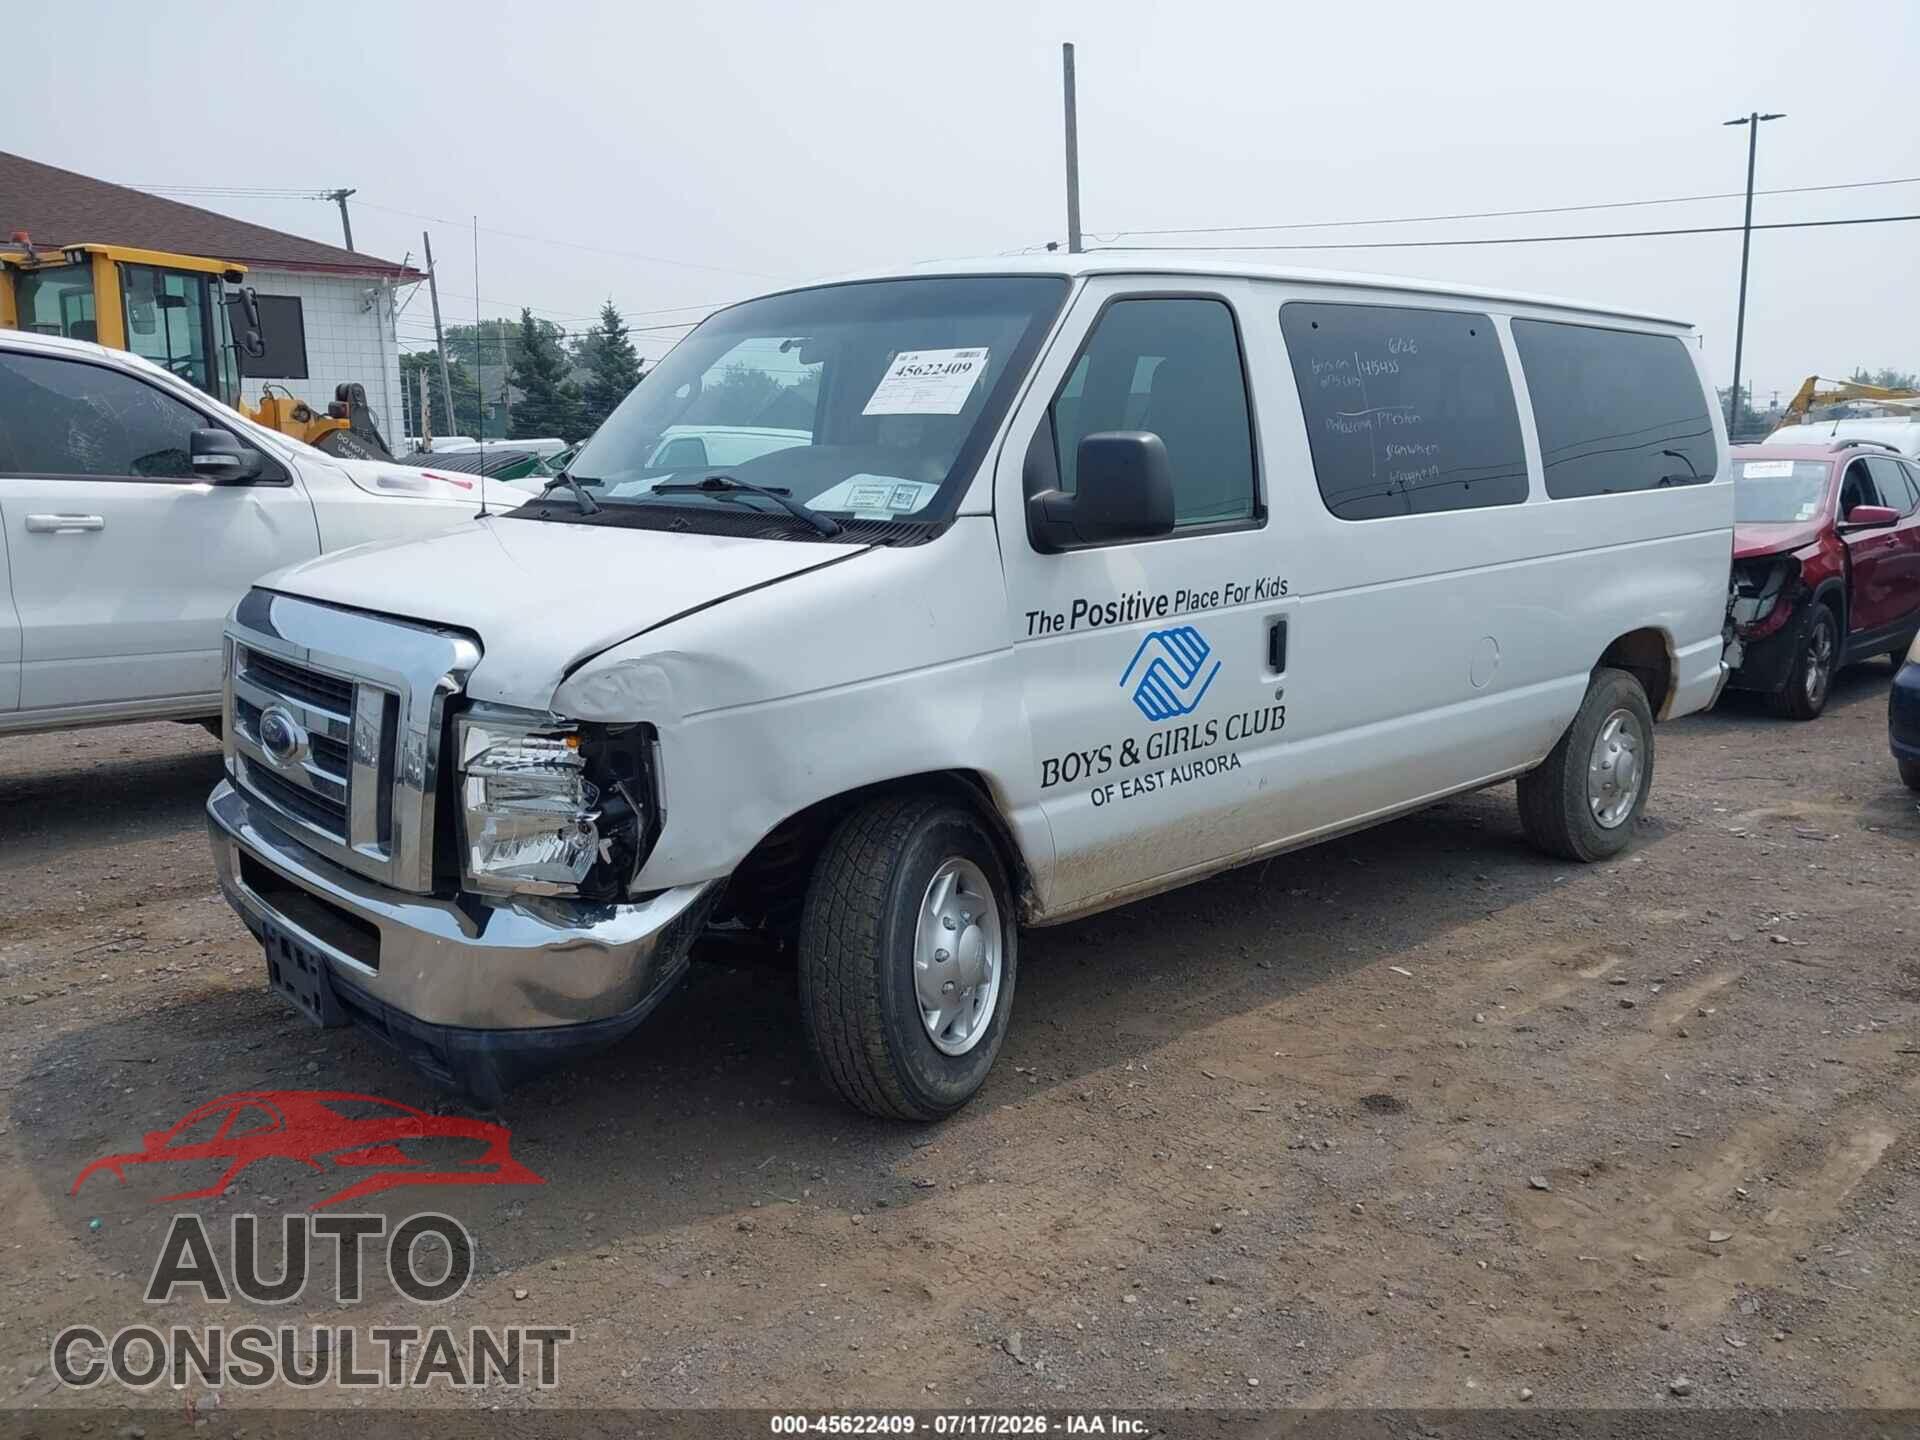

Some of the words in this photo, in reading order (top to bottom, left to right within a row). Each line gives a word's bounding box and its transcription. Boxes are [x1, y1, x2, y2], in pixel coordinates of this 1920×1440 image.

[896, 362, 972, 376] 45622409
[1025, 611, 1065, 636] The
[1070, 591, 1169, 630] Positive
[1174, 589, 1219, 613] Place
[1223, 582, 1251, 604] For
[1255, 576, 1288, 600] Kids
[1041, 745, 1112, 788] BOYS
[1119, 738, 1140, 767] &
[1146, 719, 1218, 761] GIRLS
[1225, 705, 1286, 741] CLUB
[1090, 784, 1115, 806] OF
[1120, 770, 1166, 798] EAST
[1170, 752, 1241, 786] AURORA
